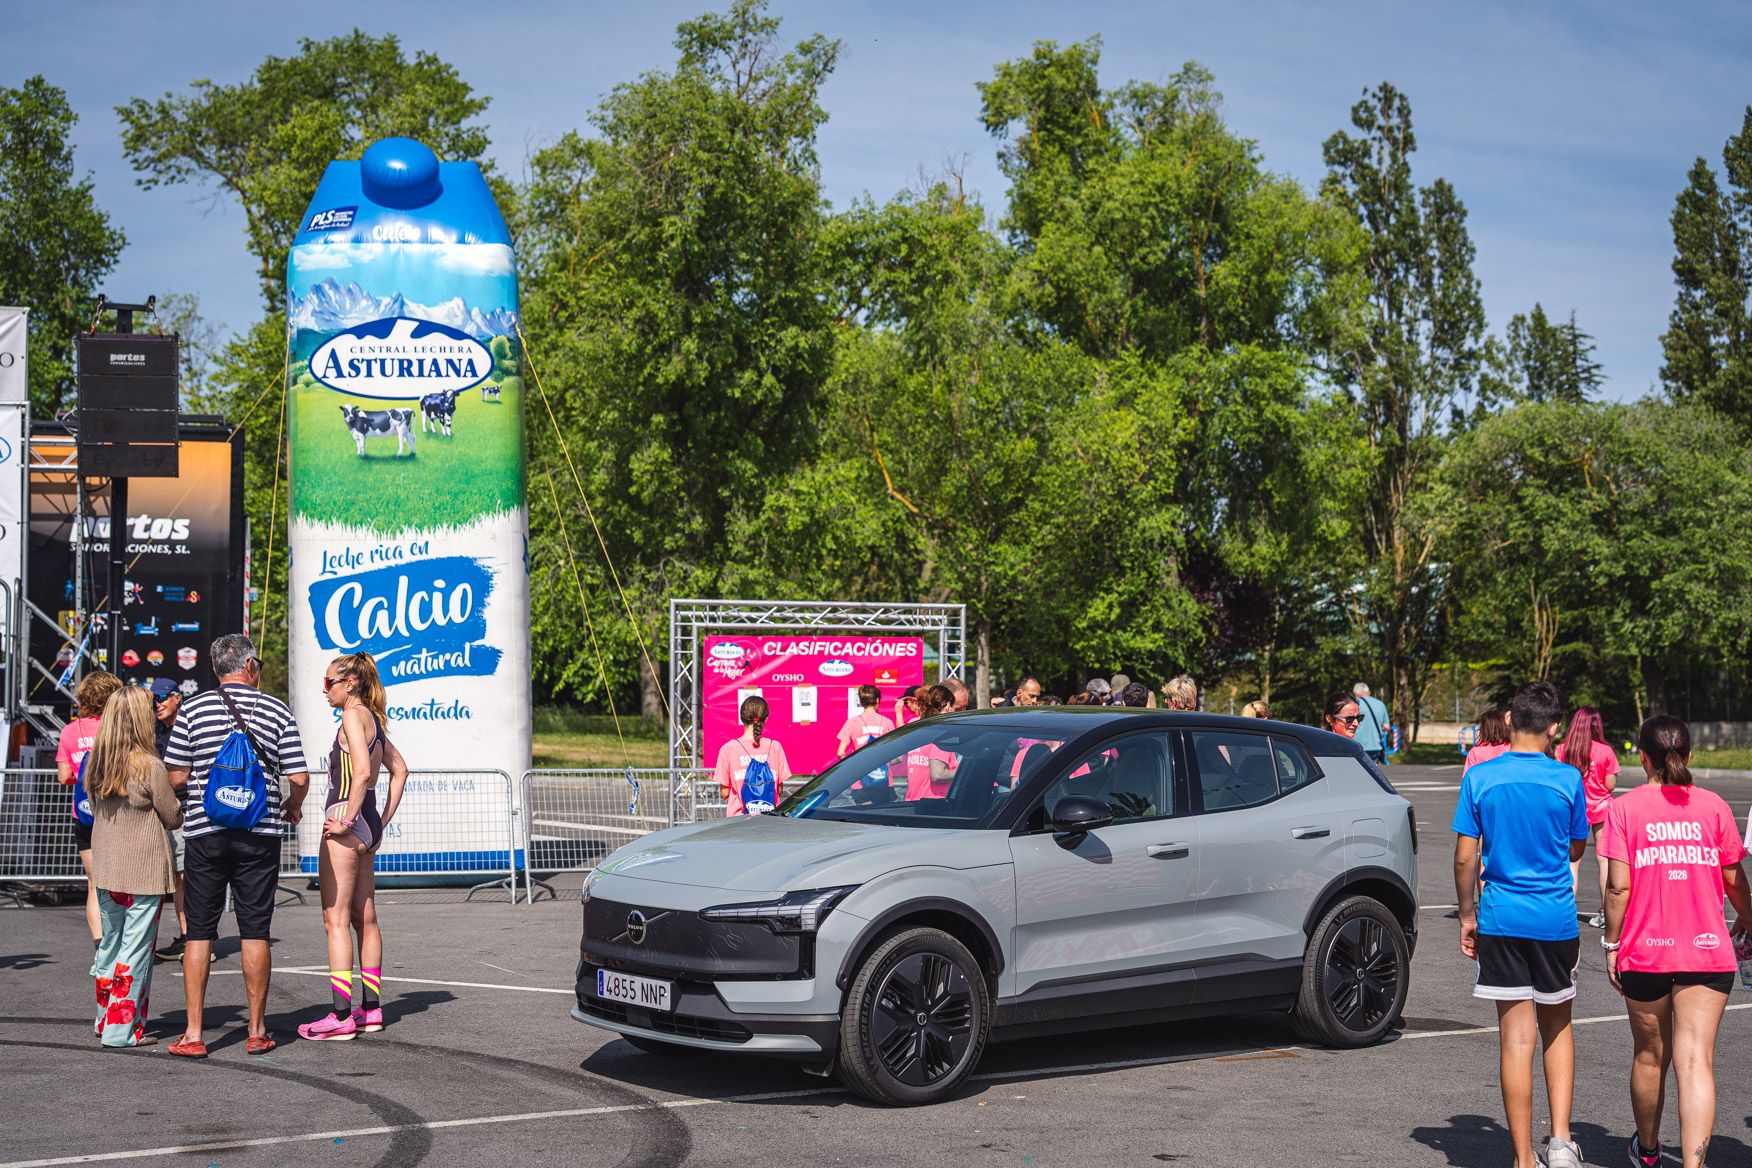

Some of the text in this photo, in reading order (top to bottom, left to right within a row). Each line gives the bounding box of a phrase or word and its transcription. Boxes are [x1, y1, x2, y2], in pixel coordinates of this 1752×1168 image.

[310, 210, 336, 228] PLS
[350, 345, 473, 354] CENTRAL LECHERA
[321, 347, 480, 379] ASTURIANA
[319, 540, 430, 577] Leche rica en
[324, 575, 473, 649] Calcio
[763, 640, 918, 656] CLASIFICACIÓNES
[391, 642, 472, 677] natural
[771, 673, 805, 682] OYSHO
[452, 778, 475, 791] VACA
[1646, 822, 1702, 841] SOMOS
[1668, 870, 1688, 880] 2026
[1646, 937, 1675, 947] OYSHO
[606, 975, 637, 1000] 4855
[641, 982, 667, 1005] NNP
